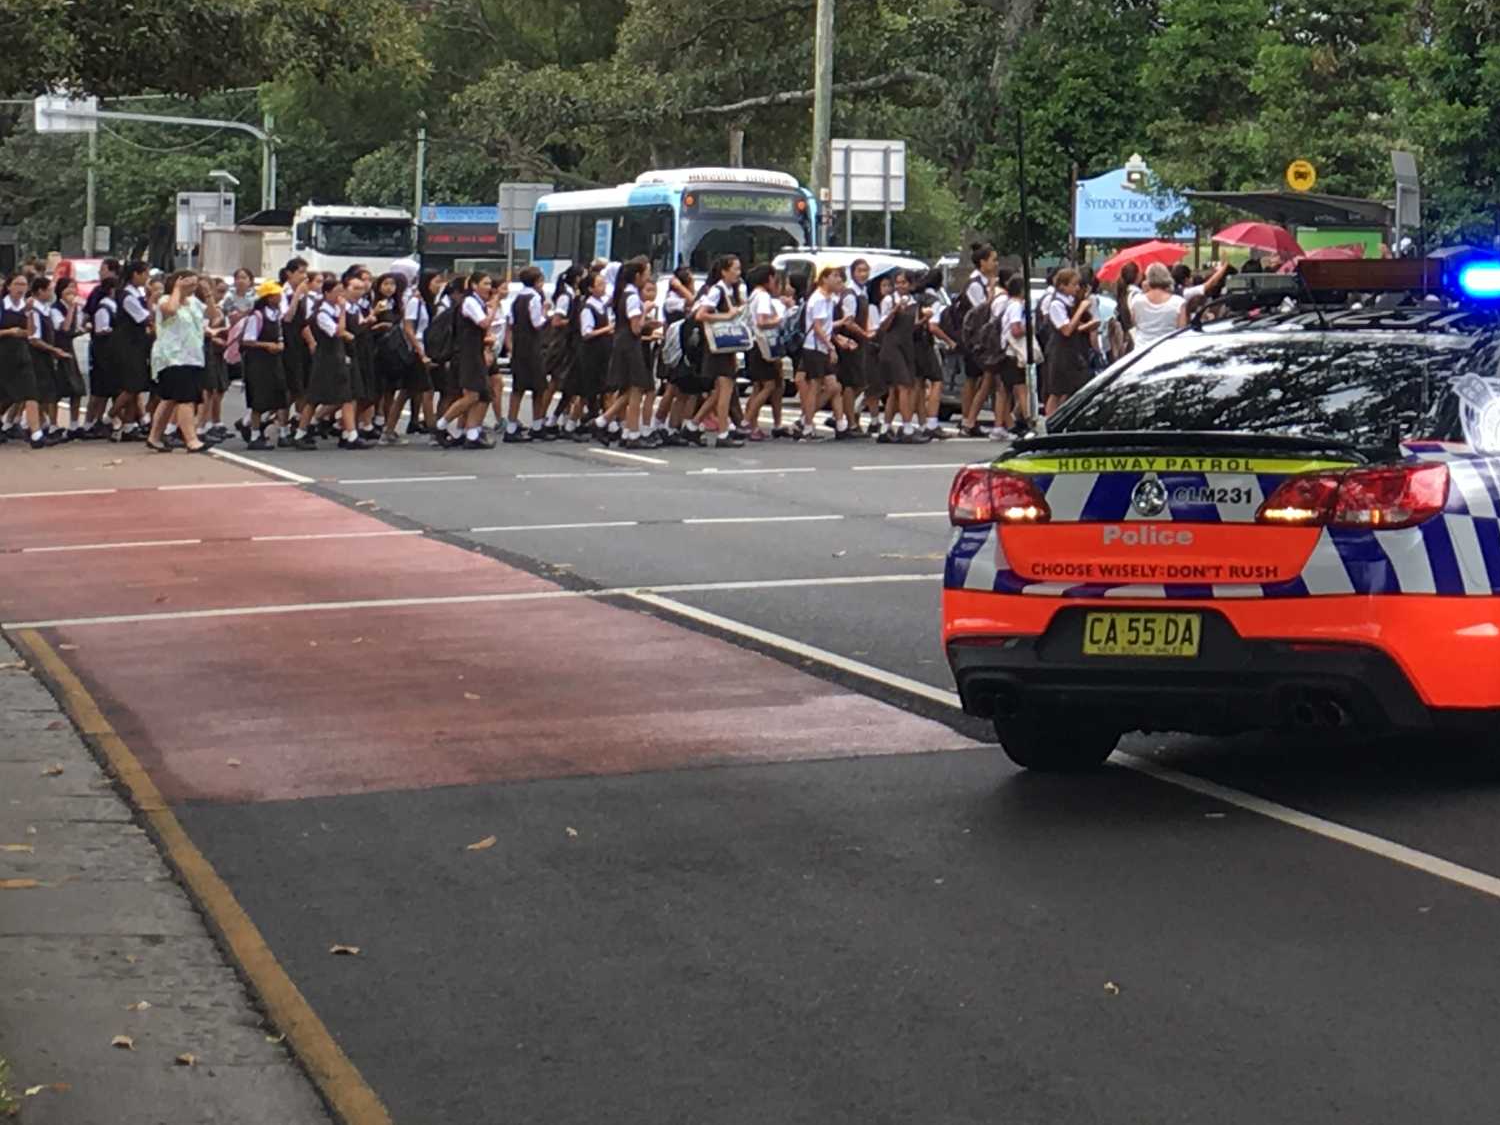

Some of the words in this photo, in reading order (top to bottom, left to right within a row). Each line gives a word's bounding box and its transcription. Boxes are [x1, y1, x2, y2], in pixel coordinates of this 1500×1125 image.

[1085, 198, 1126, 210] SYDNEY
[1128, 198, 1153, 210] BOY
[1112, 212, 1153, 223] SCHOOL
[1058, 458, 1156, 471] HIGHWAY
[1166, 458, 1254, 471] PATROL
[1174, 488, 1252, 504] CLM231
[1103, 525, 1193, 545] Police
[1031, 562, 1093, 576] CHOOSE
[1229, 566, 1279, 579] RUSH
